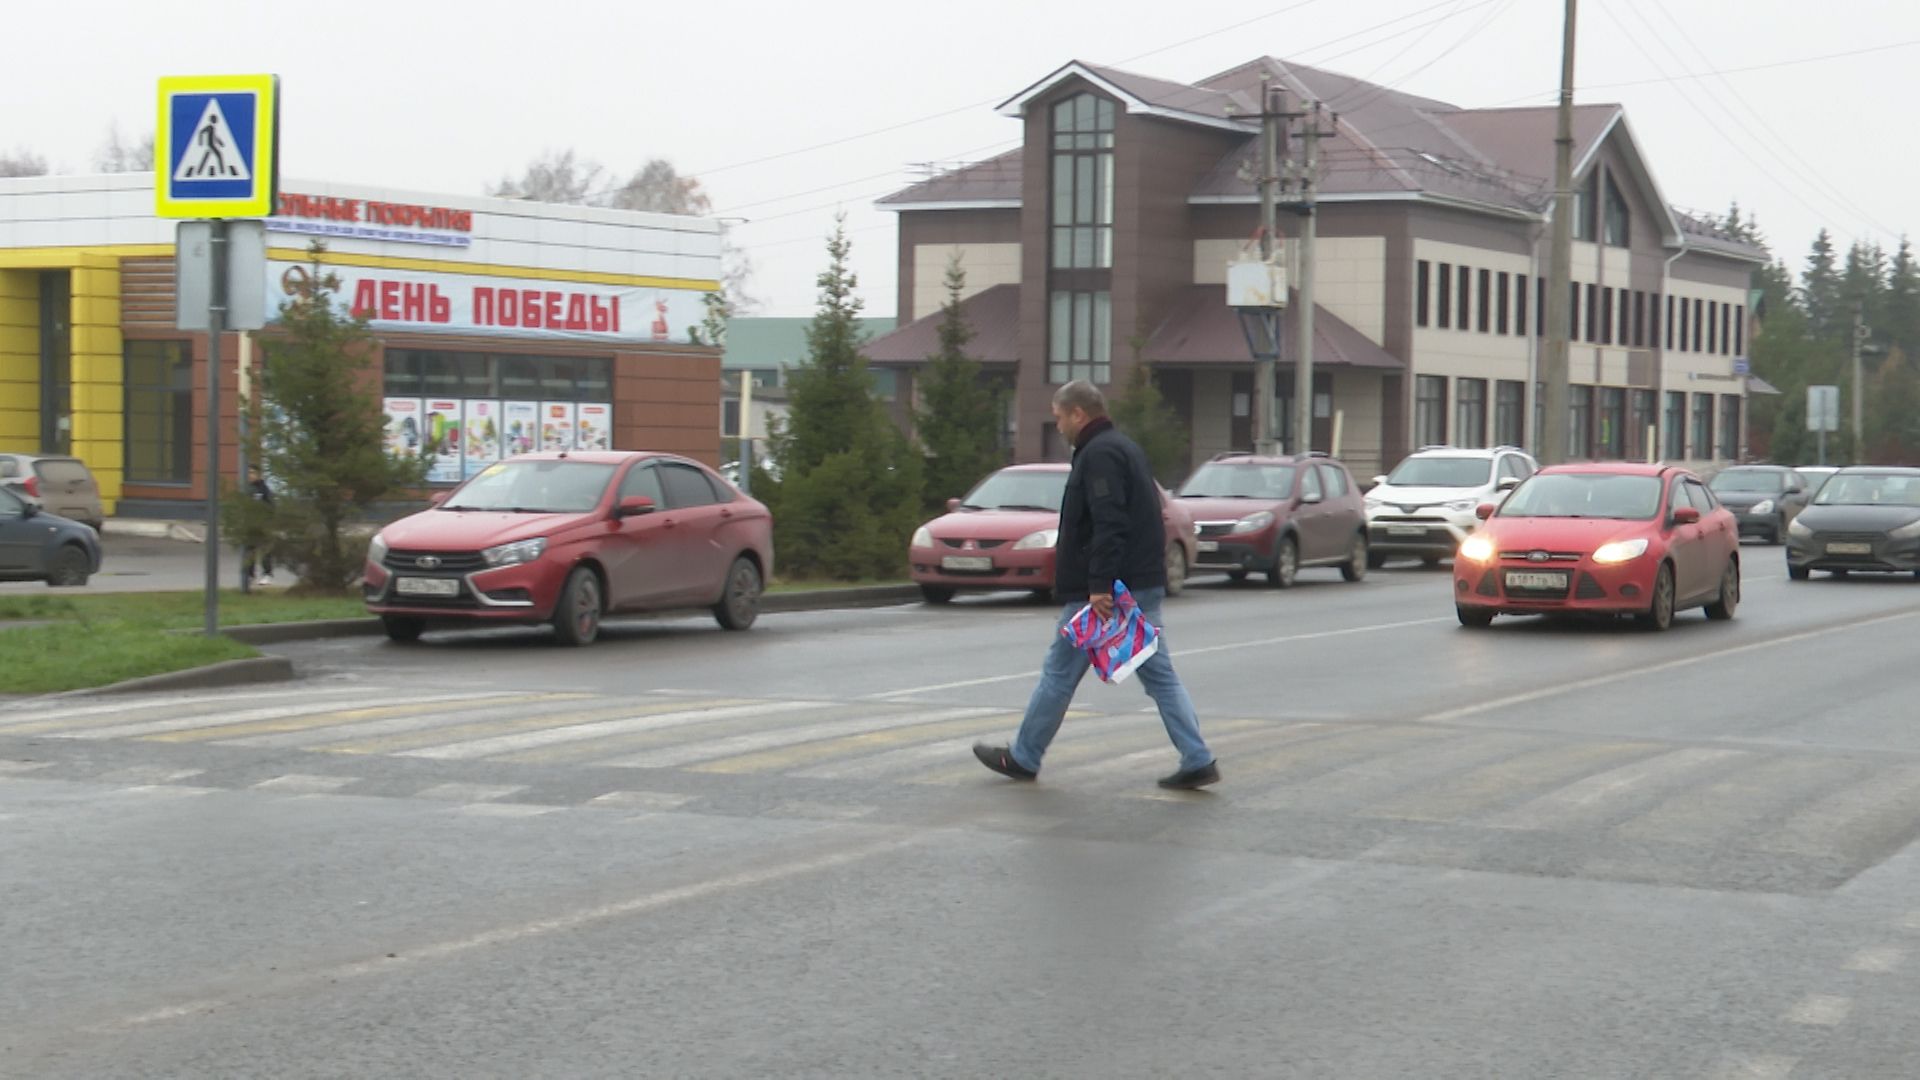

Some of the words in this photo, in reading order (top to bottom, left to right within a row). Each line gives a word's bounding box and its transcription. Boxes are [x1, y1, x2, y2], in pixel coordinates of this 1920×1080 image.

[367, 201, 472, 232] ПОКРЫТИЯ
[350, 278, 452, 323] ДЕНЬ
[473, 286, 620, 332] ПОБЕДЫ
